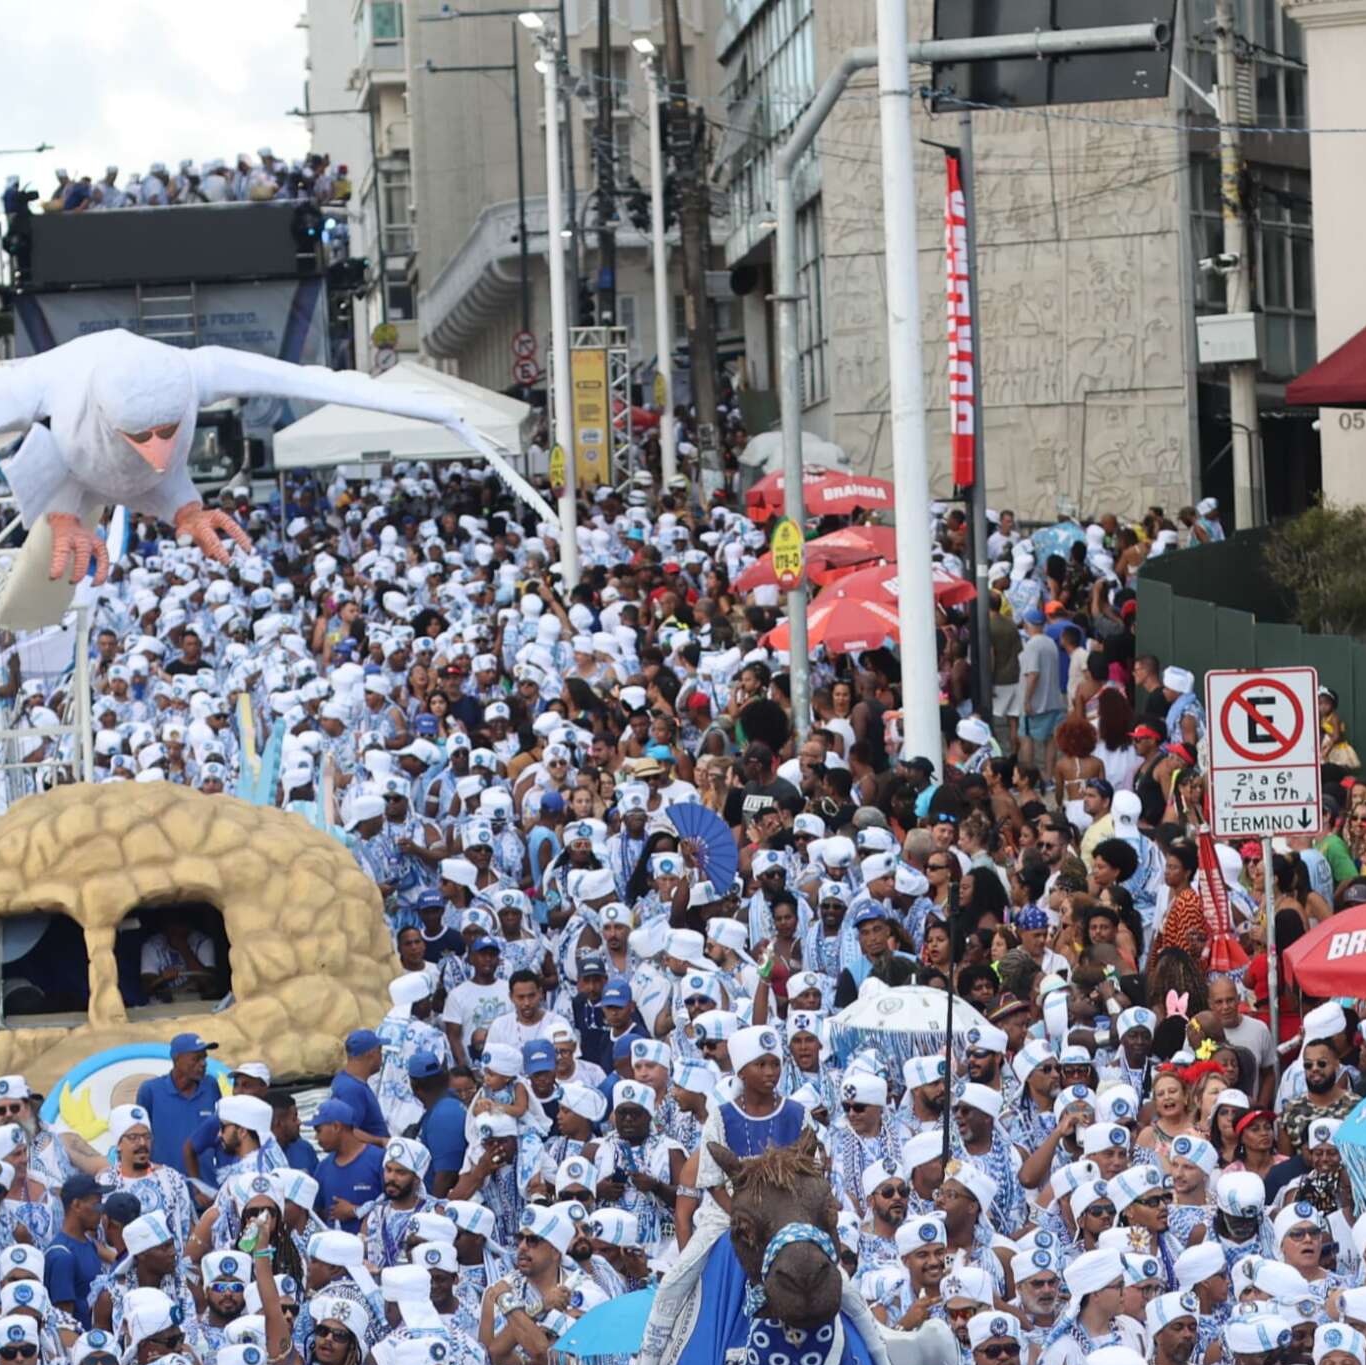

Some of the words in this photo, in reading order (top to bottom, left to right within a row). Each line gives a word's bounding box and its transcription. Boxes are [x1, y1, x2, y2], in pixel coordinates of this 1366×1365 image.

[1339, 412, 1366, 431] 05
[822, 484, 887, 501] BRAHMA
[1260, 775, 1269, 785] a
[1232, 789, 1241, 801] 7
[1249, 786, 1266, 801] às
[1273, 787, 1299, 801] 17h
[1221, 812, 1293, 833] TÉRMINO
